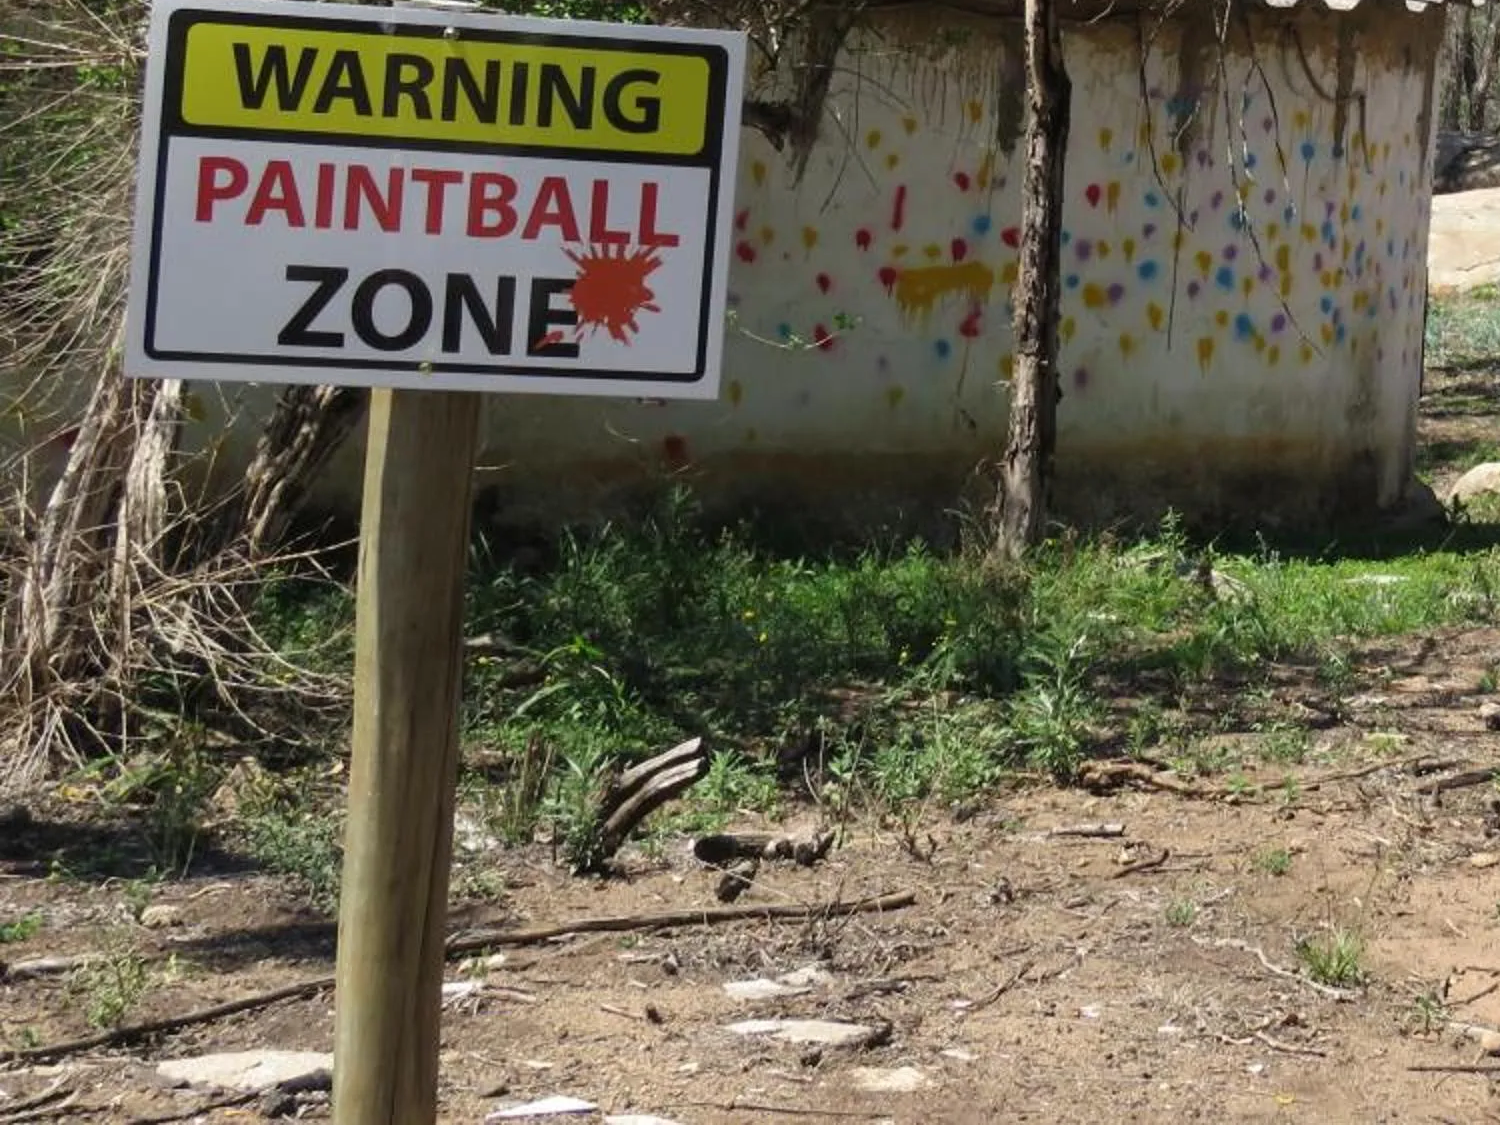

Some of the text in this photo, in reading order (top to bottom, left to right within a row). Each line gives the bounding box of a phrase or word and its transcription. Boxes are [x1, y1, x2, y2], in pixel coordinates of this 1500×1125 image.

[233, 42, 662, 134] WARNING
[194, 156, 680, 248] PAINTBALL
[277, 265, 581, 359] ZONE
